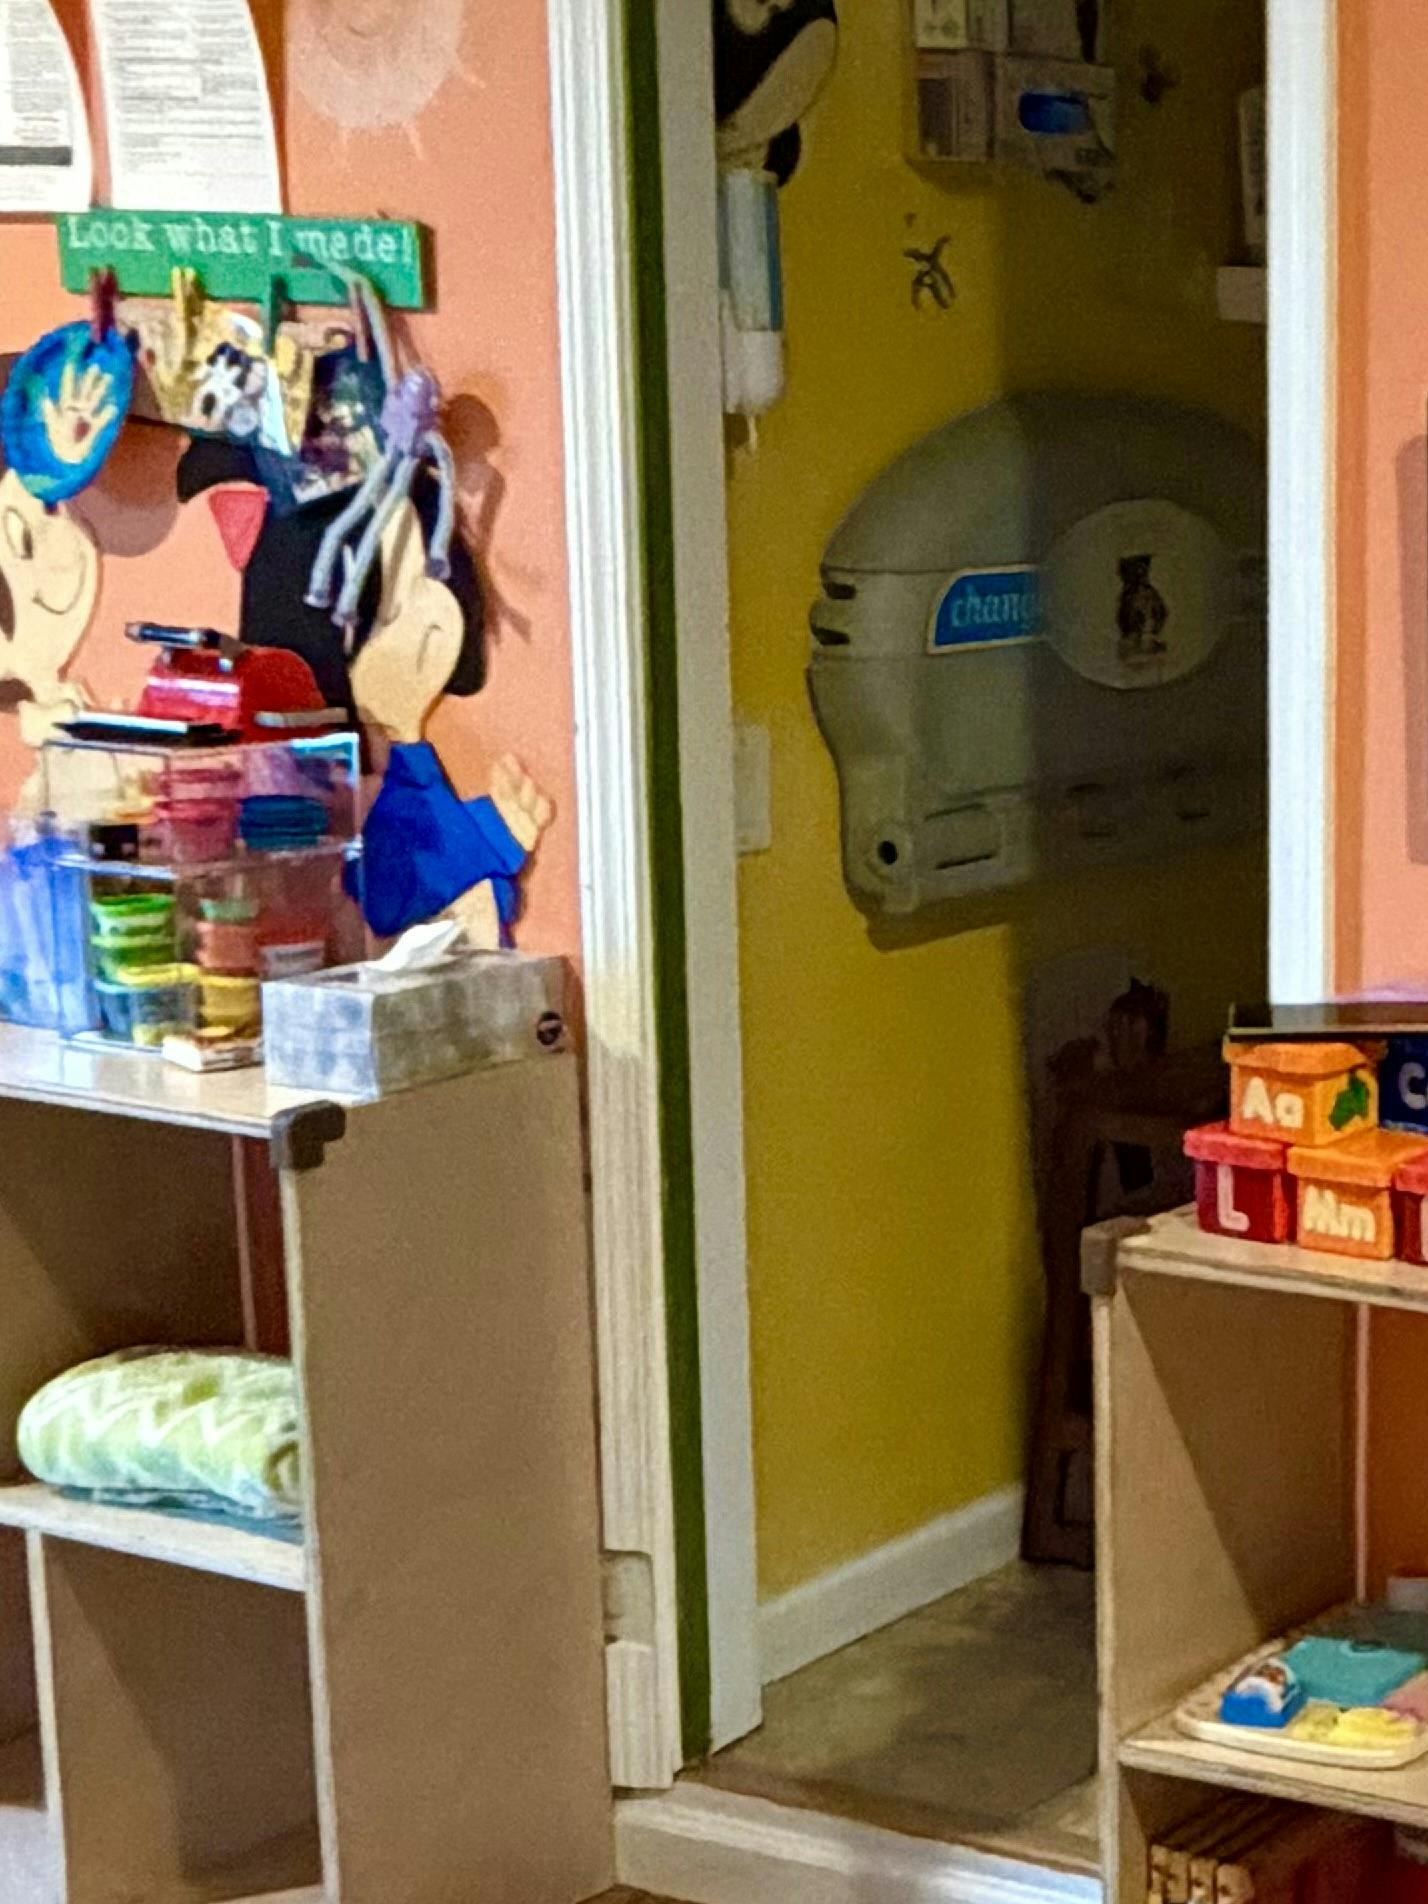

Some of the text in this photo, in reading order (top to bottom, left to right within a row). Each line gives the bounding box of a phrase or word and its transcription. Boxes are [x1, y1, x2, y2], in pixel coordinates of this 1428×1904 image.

[64, 218, 156, 251] Look
[161, 218, 261, 256] what
[266, 220, 284, 257] I
[1241, 1077, 1302, 1127] Aa
[1216, 1165, 1250, 1231] L
[1302, 1185, 1376, 1243] Mm
